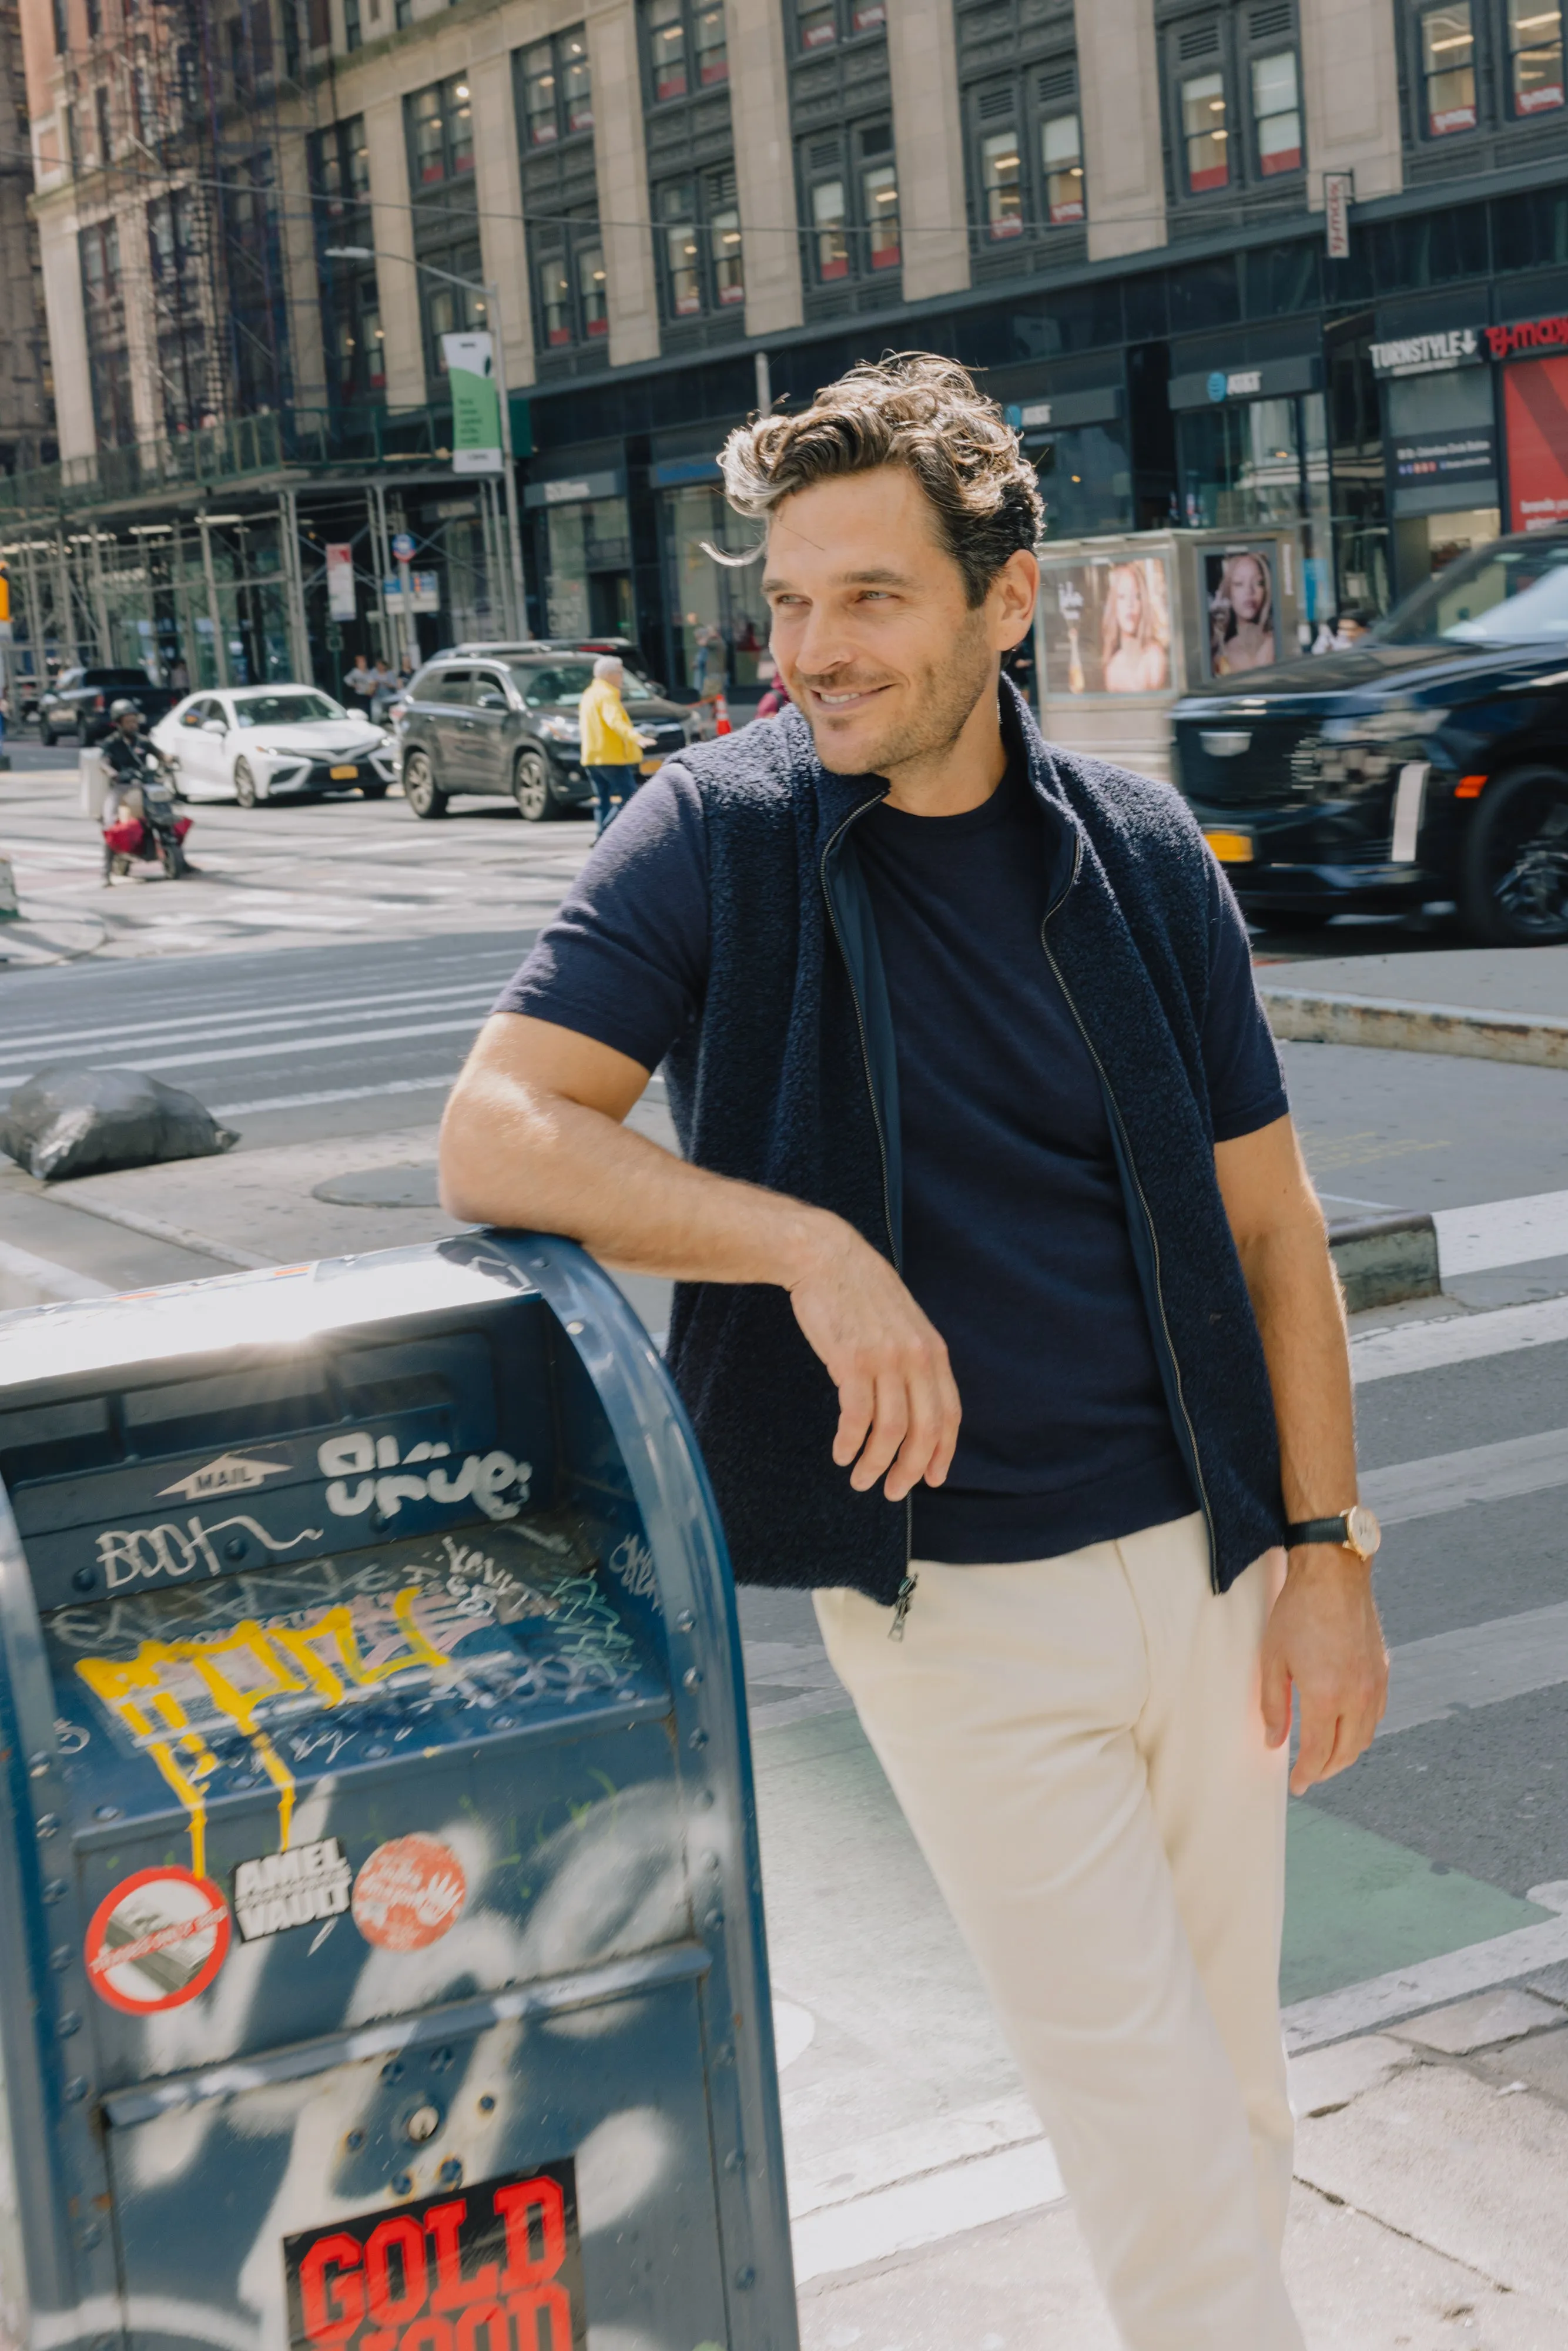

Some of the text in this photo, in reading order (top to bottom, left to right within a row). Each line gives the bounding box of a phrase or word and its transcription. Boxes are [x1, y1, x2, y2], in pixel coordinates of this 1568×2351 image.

[196, 1466, 253, 1492] MAIL
[236, 1837, 346, 1902] AMEL
[236, 1878, 351, 1940] VAULT
[299, 2176, 567, 2344] GOLD
